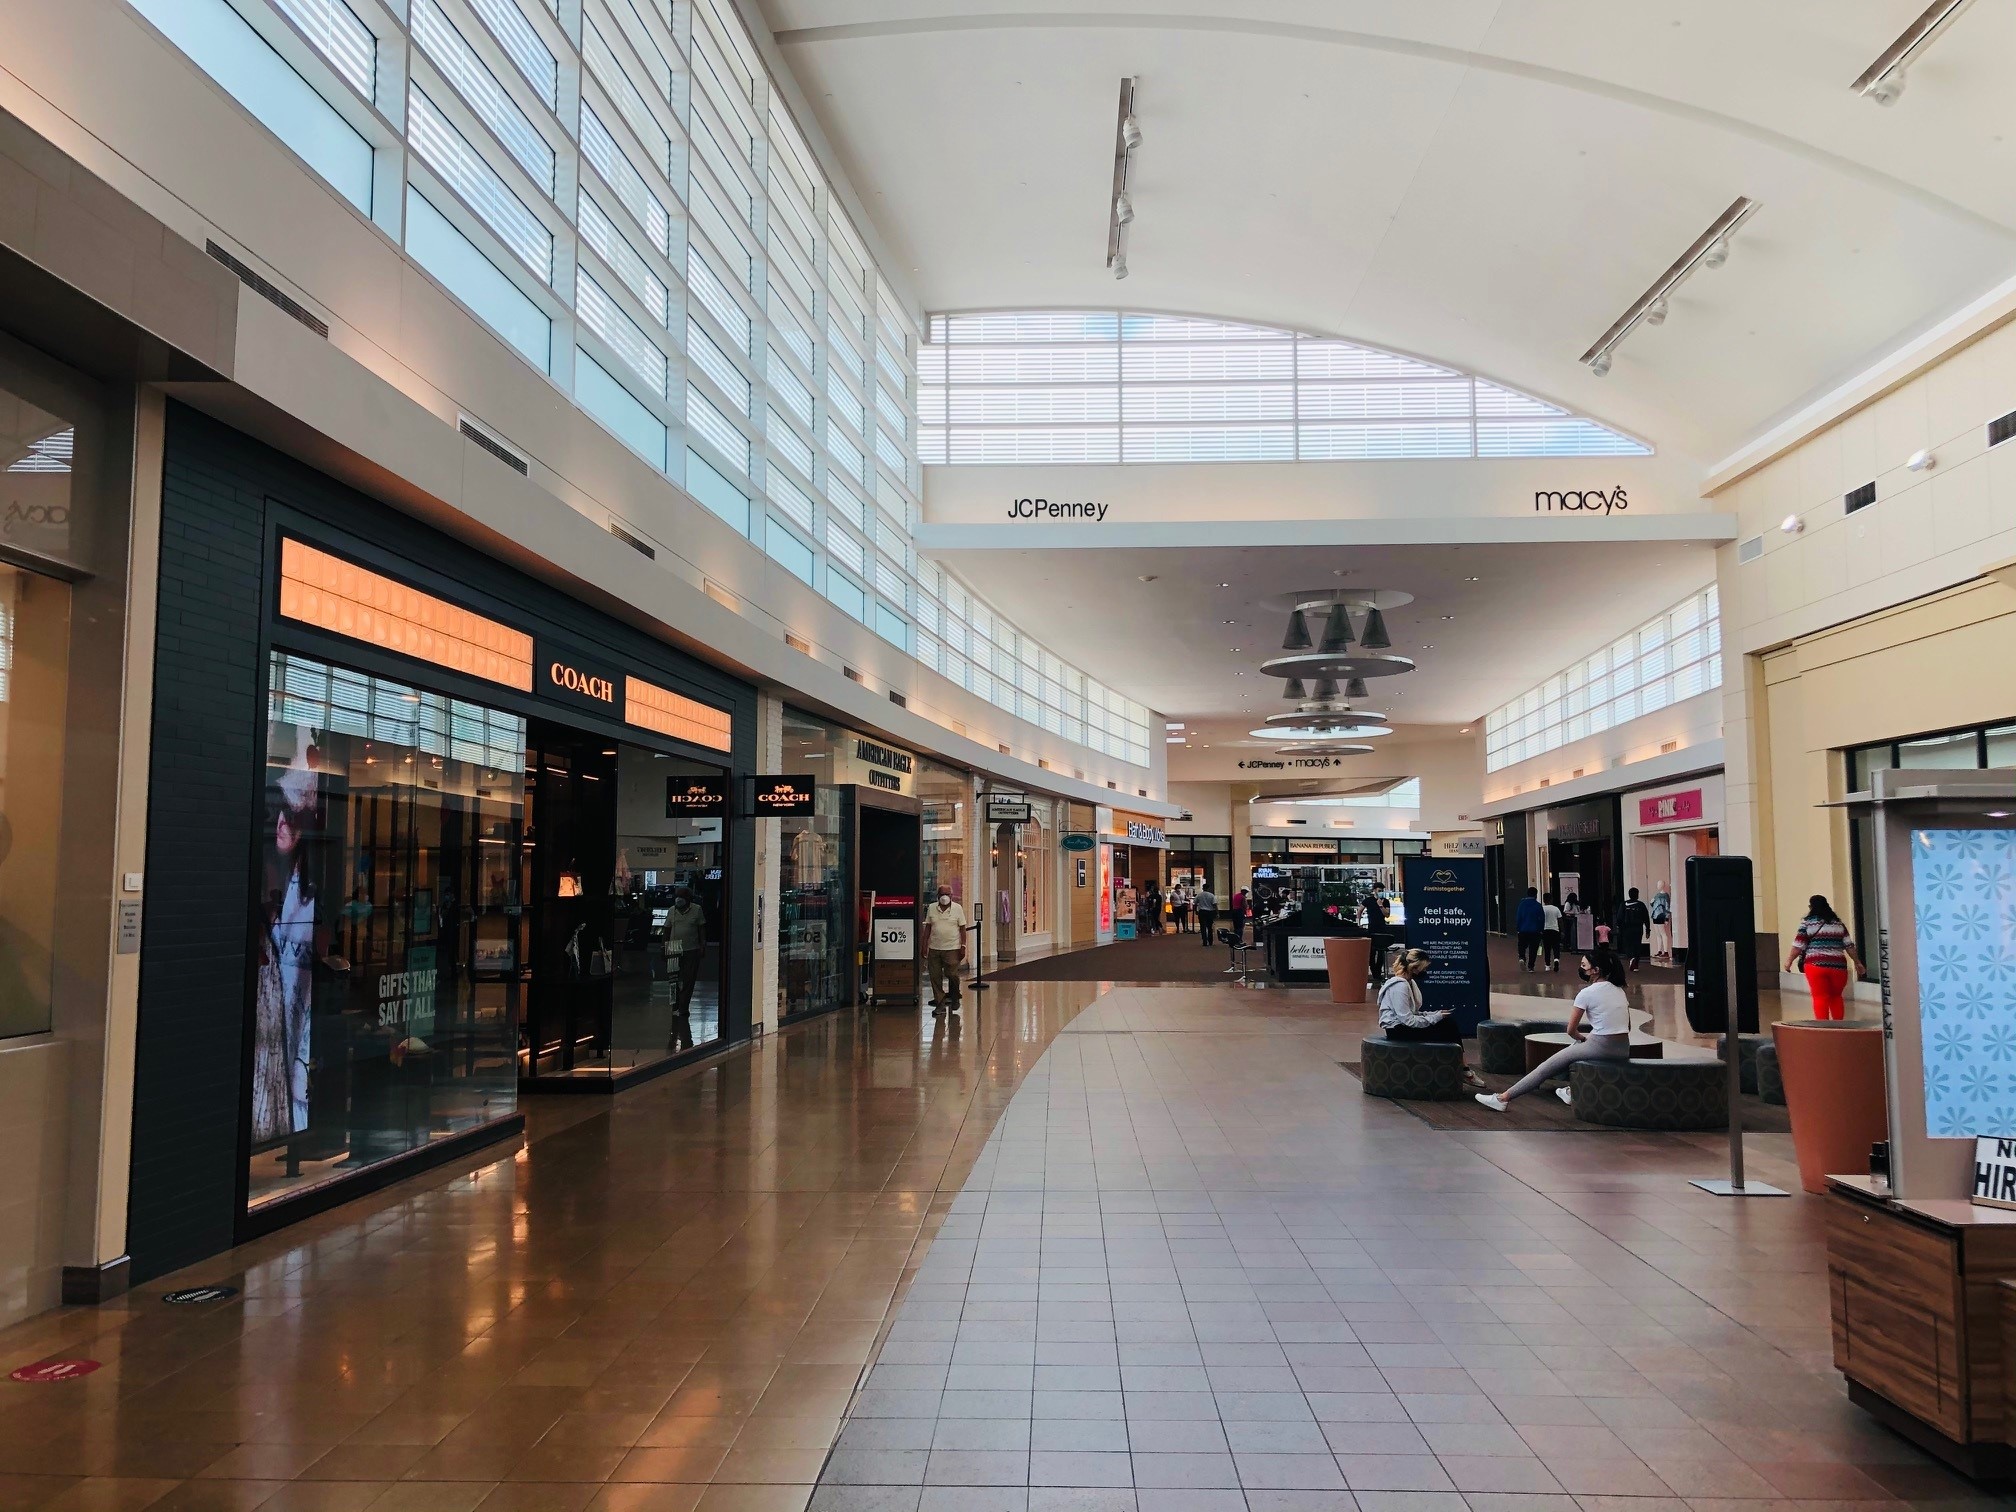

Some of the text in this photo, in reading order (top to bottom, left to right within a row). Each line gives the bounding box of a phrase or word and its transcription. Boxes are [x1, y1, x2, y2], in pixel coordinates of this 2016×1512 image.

[1008, 499, 1108, 521] JCPenney
[1536, 485, 1628, 515] macy's
[551, 662, 613, 702] COACH
[1247, 757, 1330, 769] JCPenney macy's
[758, 794, 810, 802] COACH
[1658, 798, 1677, 818] PINK
[1418, 916, 1472, 926] shop happy
[1444, 907, 1466, 916] safe,
[881, 931, 906, 943] 50%
[1290, 945, 1310, 953] bella
[1880, 938, 1891, 1006] PERFUME
[378, 969, 437, 998] GIFTS THAT
[378, 996, 436, 1026] SAY IT ALL.
[1884, 1011, 1893, 1040] SKY
[1997, 1140, 2016, 1159] N
